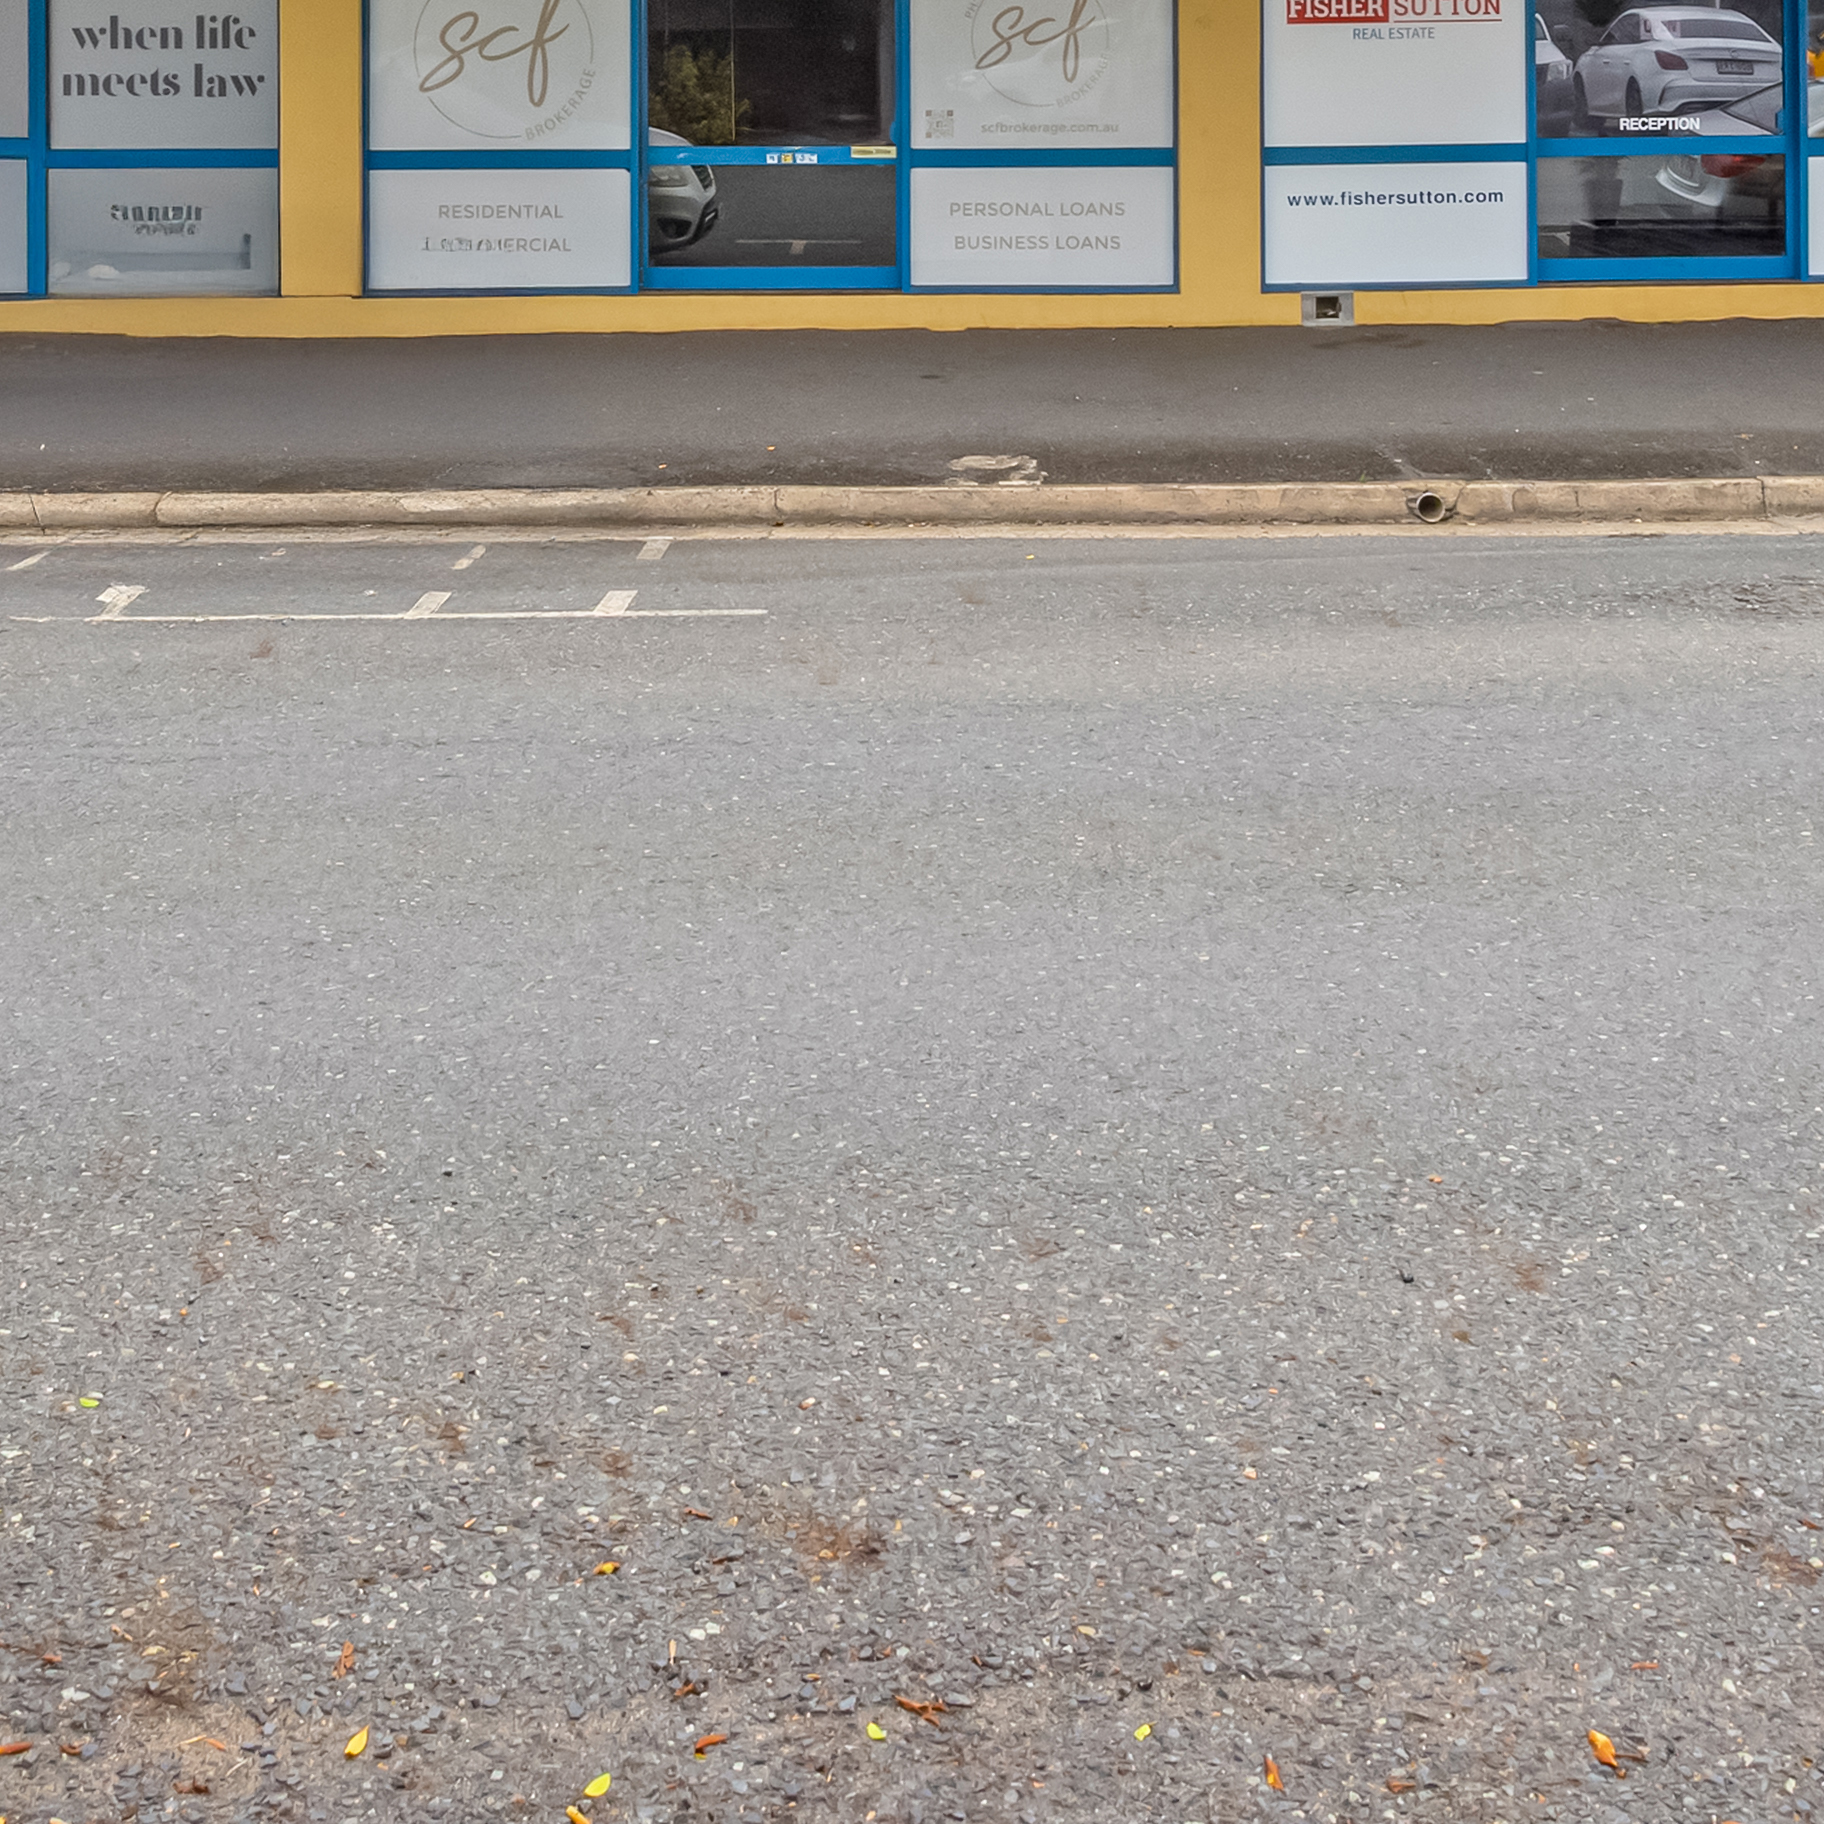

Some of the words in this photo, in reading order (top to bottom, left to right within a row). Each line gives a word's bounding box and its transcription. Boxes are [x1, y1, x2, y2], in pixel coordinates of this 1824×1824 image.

[71, 15, 184, 51] when
[195, 14, 257, 50] life
[1352, 27, 1385, 41] REAL
[1388, 26, 1436, 40] ESTATE
[62, 67, 181, 97] meets
[194, 63, 266, 98] law
[1056, 53, 1110, 109] BROKERAGE
[526, 68, 597, 141] BROKERAGE
[980, 121, 1120, 136] scfbrokerage.com.au
[1619, 117, 1701, 132] RECEPTION
[1286, 189, 1504, 208] www.fishersutton.com
[438, 204, 564, 220] RESIDENTIAL
[949, 201, 1055, 217] PERSONAL
[1060, 201, 1126, 217] LOANS
[954, 235, 1050, 251] BUSINESS
[1055, 235, 1121, 250] LOANS
